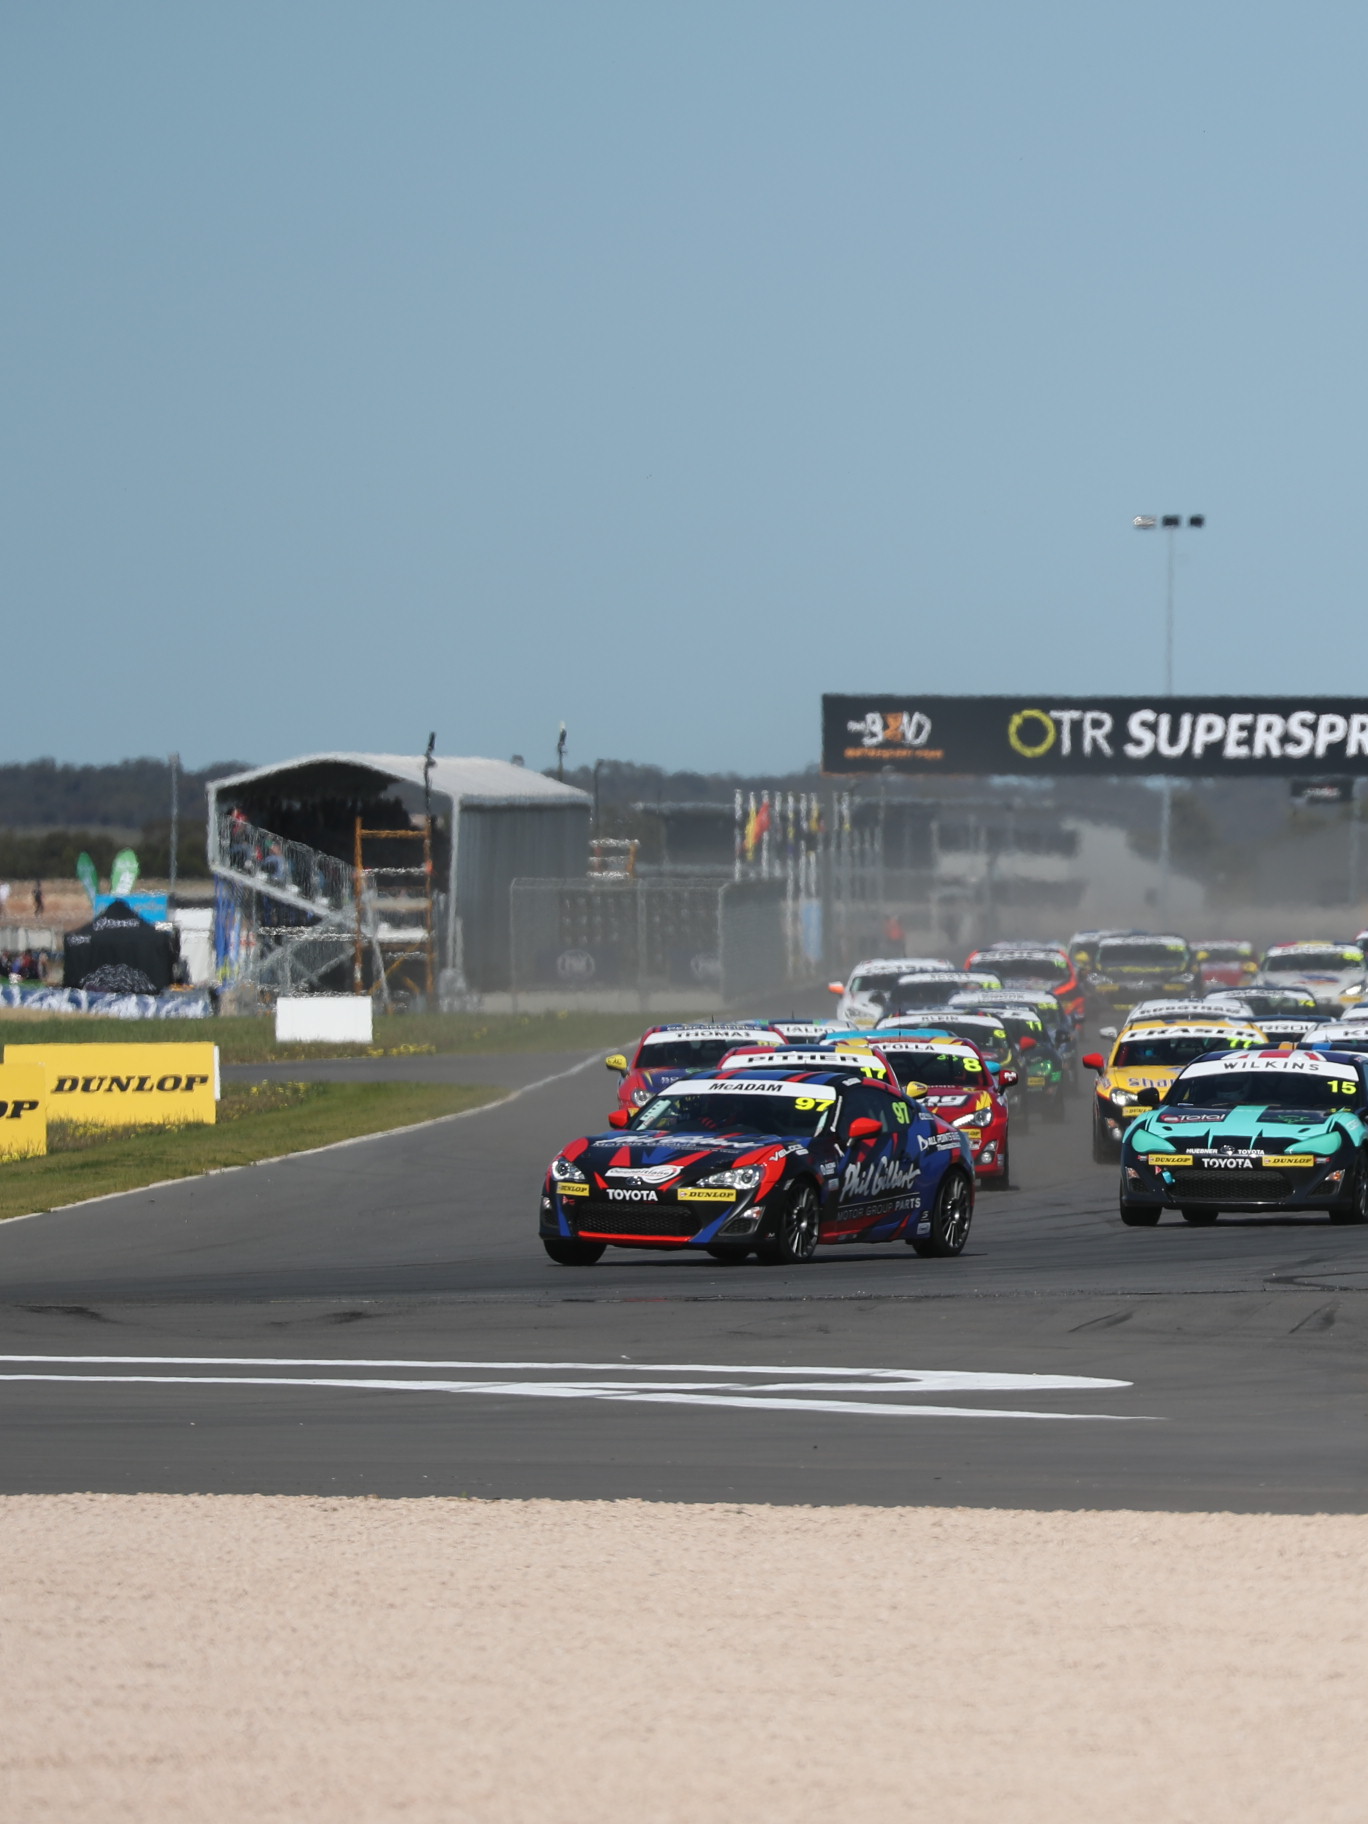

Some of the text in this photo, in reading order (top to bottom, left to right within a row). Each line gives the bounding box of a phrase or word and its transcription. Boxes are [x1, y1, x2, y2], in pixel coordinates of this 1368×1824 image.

[1008, 709, 1113, 757] OTR
[1026, 1020, 1043, 1032] 11
[1128, 1027, 1258, 1039] FRASER
[747, 1054, 859, 1063] PITHER
[962, 1057, 983, 1073] 8
[1223, 1060, 1320, 1071] WILKINS
[860, 1066, 887, 1080] 17
[51, 1074, 209, 1093] DUNLOP
[708, 1082, 783, 1093] McADAM
[1327, 1080, 1358, 1095] 15
[794, 1097, 835, 1112] 97
[892, 1101, 910, 1124] 97
[1178, 1113, 1226, 1121] Total
[1201, 1157, 1253, 1169] TOYOTA
[1272, 1157, 1313, 1165] DUNLOP
[871, 1156, 921, 1196] Gilbert
[560, 1184, 588, 1193] DUNLOP
[606, 1188, 659, 1201] TOYOTA
[688, 1191, 735, 1199] DUNLOP
[837, 1197, 921, 1221] MOTOR GROUP PARTS
